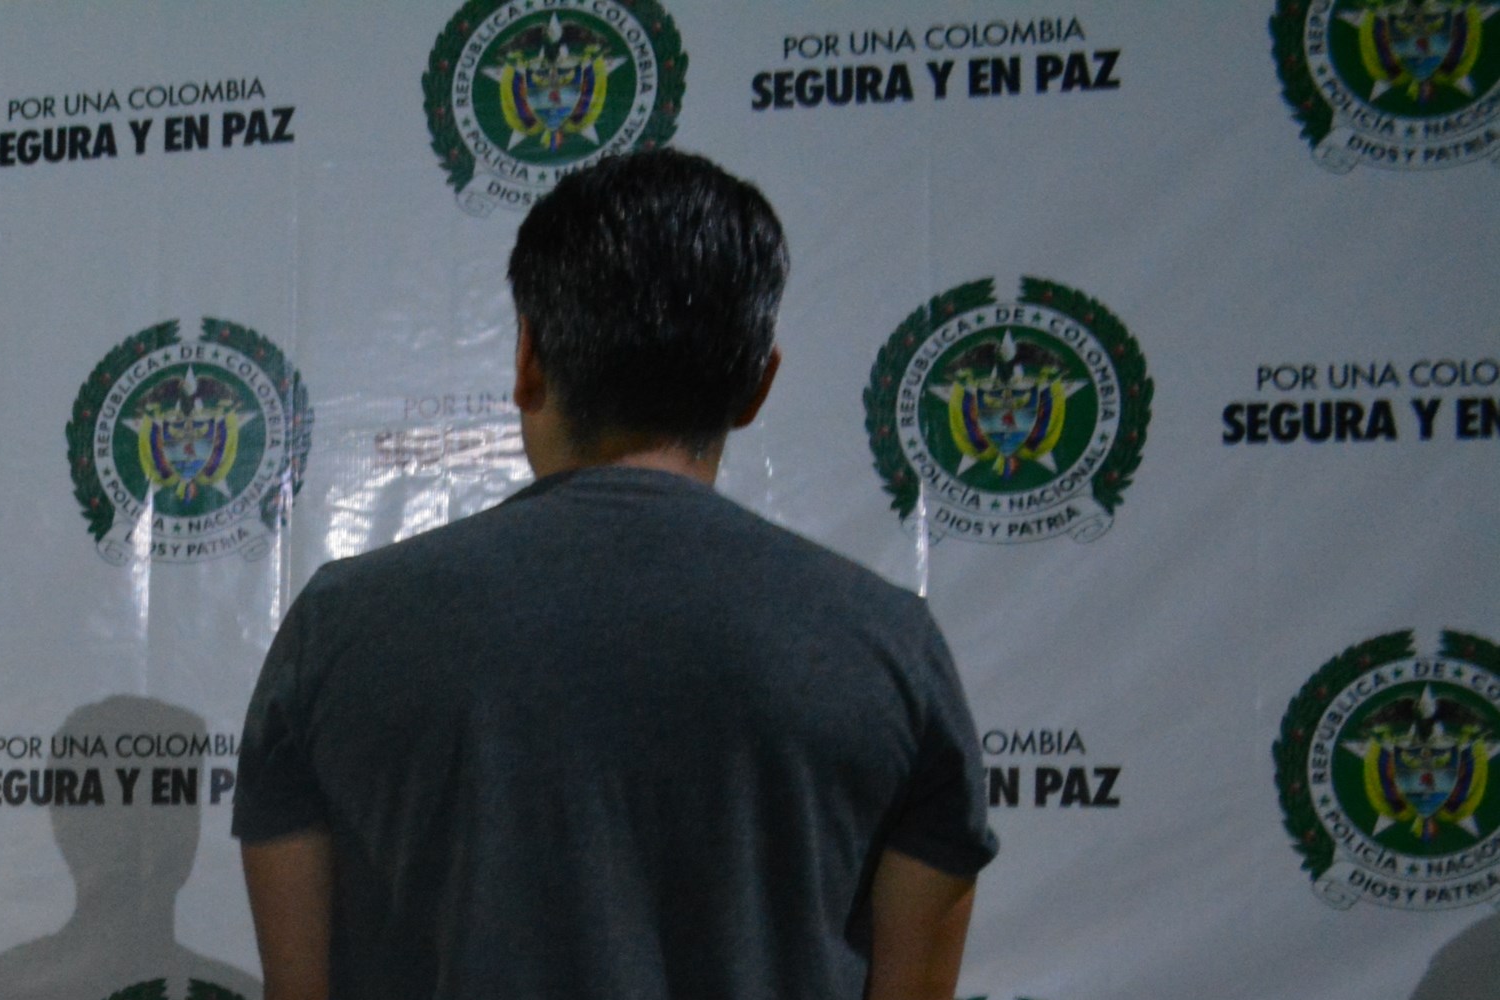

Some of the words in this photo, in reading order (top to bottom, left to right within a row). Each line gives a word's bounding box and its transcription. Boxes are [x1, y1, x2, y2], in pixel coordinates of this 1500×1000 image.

[782, 32, 840, 61] POR
[848, 27, 917, 57] UNA
[923, 17, 1086, 52] COLOMBIA
[7, 95, 56, 122] POR
[63, 89, 122, 117] UNA
[127, 76, 266, 111] COLOMBIA
[751, 62, 914, 111] SEGURA
[926, 59, 955, 100] Y
[968, 55, 1021, 97] EN
[1035, 49, 1121, 94] PAZ
[128, 118, 153, 156] Y
[164, 113, 210, 153] EN
[221, 106, 295, 148] PAZ
[995, 306, 1026, 322] DE
[1048, 317, 1117, 422] COLOMBIA
[1256, 364, 1319, 392] POR
[1327, 361, 1402, 391] UNA
[1407, 358, 1500, 389] COLO
[1222, 398, 1398, 446] SEGURA
[1410, 397, 1442, 441] Y
[1007, 445, 1107, 511] NACIONAL
[935, 507, 983, 536] DIOS
[986, 522, 997, 536] Y
[1006, 505, 1082, 537] PATRIA
[50, 734, 109, 760] UNA
[981, 728, 1088, 756] OMBIA
[115, 767, 141, 806] Y
[151, 767, 198, 805] EN
[1034, 766, 1121, 808] PAZ
